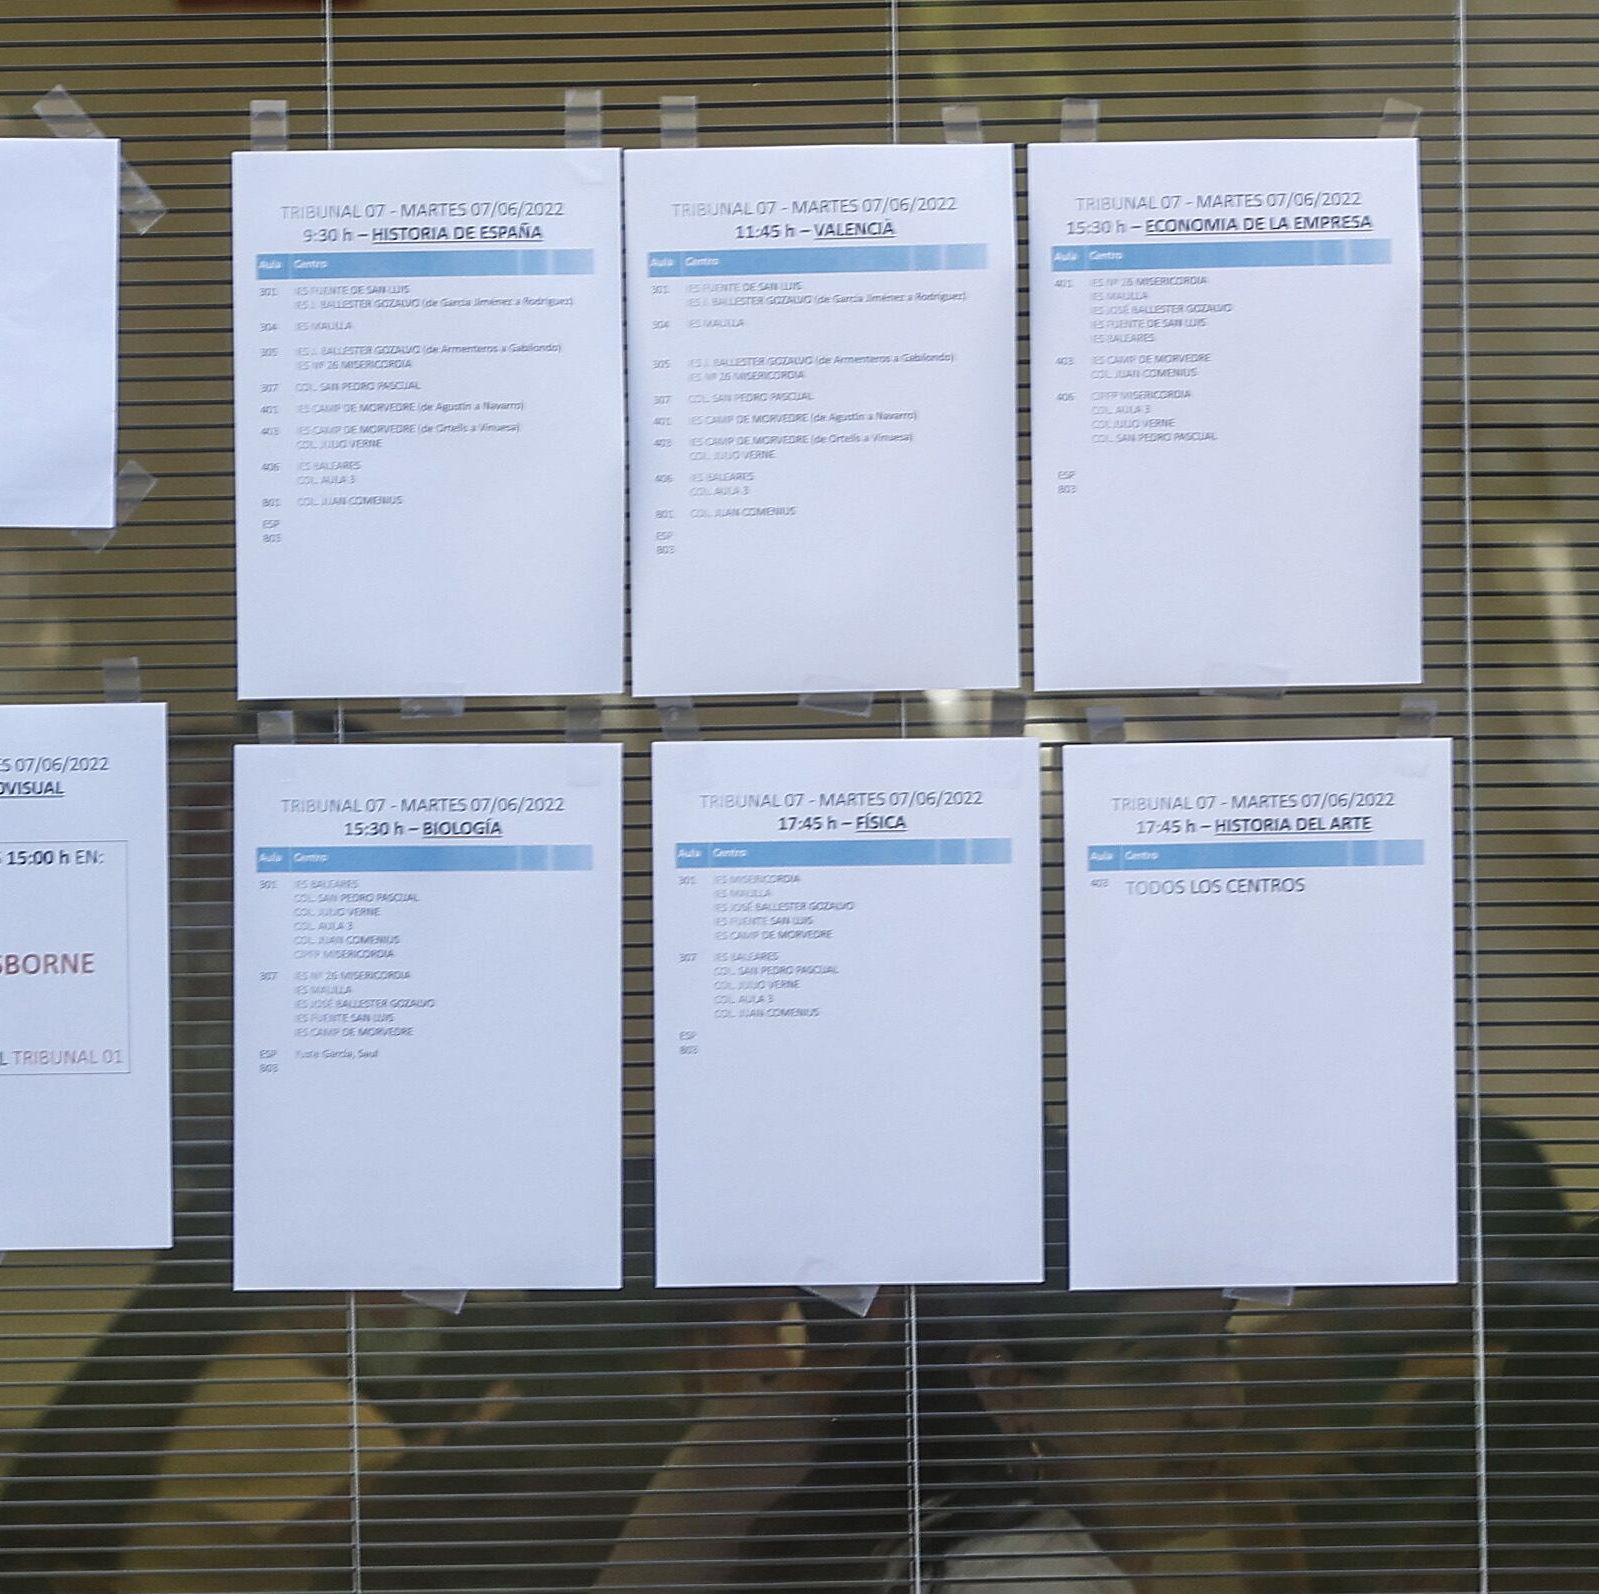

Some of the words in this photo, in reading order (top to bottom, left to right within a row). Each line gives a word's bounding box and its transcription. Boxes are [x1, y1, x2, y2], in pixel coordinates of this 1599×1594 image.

[282, 205, 363, 220] TRIBUNAL
[365, 204, 384, 219] 07
[400, 203, 466, 218] MARTES
[470, 201, 564, 219] 07/06/2022
[672, 201, 754, 218] TRIBUNAL
[757, 201, 775, 216] 07
[792, 199, 857, 215] MARTES
[863, 196, 957, 214] 07/06/2022
[1076, 196, 1159, 212] TRIBUNAL
[1162, 195, 1179, 210] 07
[1197, 194, 1262, 209] MARTES
[1267, 191, 1361, 209] 07/06/2022
[303, 228, 337, 242] 9:30
[344, 228, 352, 242] h
[373, 227, 447, 241] HISTORIA
[454, 226, 474, 240] DE
[481, 222, 542, 240] ESPAÑA
[736, 224, 779, 239] 11:45
[786, 224, 794, 238] h
[1067, 220, 1111, 235] 15:30
[1117, 220, 1125, 234] h
[1146, 218, 1237, 234] ECONOMIA
[1244, 218, 1264, 232] DE
[1270, 217, 1289, 231] LA
[1294, 216, 1371, 231] EMPRESA
[294, 259, 327, 269] Centro
[1089, 251, 1123, 260] Centro
[15, 756, 109, 774] 07/06/2022
[281, 799, 363, 813] TRIBUNAL
[366, 799, 385, 812] 07
[401, 798, 466, 812] MARTES
[471, 796, 564, 813] 07/06/2022
[699, 793, 783, 809] TRIBUNAL
[785, 793, 803, 807] 07
[820, 792, 885, 807] MARTES
[890, 790, 982, 807] 07/06/2022
[1112, 796, 1193, 811] TRIBUNAL
[1196, 795, 1216, 810] 07
[1231, 794, 1297, 809] MARTES
[1302, 791, 1394, 809] 07/06/2022
[345, 822, 388, 836] 15:30
[394, 822, 403, 836] h
[423, 818, 501, 835] BIOLOGÍA
[779, 816, 821, 831] 17:45
[828, 816, 836, 830] h
[857, 812, 906, 829] FÍSICA
[1137, 820, 1181, 834] 17:45
[1186, 820, 1195, 833] h
[1216, 818, 1290, 833] HISTORIA
[1297, 817, 1325, 831] DEL
[1330, 816, 1371, 831] ARTE
[8, 850, 53, 865] 15:00
[59, 850, 69, 864] h
[76, 850, 103, 864] EN:
[1126, 880, 1184, 895] TODOS
[1191, 880, 1221, 894] LOS
[1227, 878, 1305, 893] CENTROS
[13, 1050, 97, 1066] TRIBUNAL
[102, 1050, 122, 1064] 01
